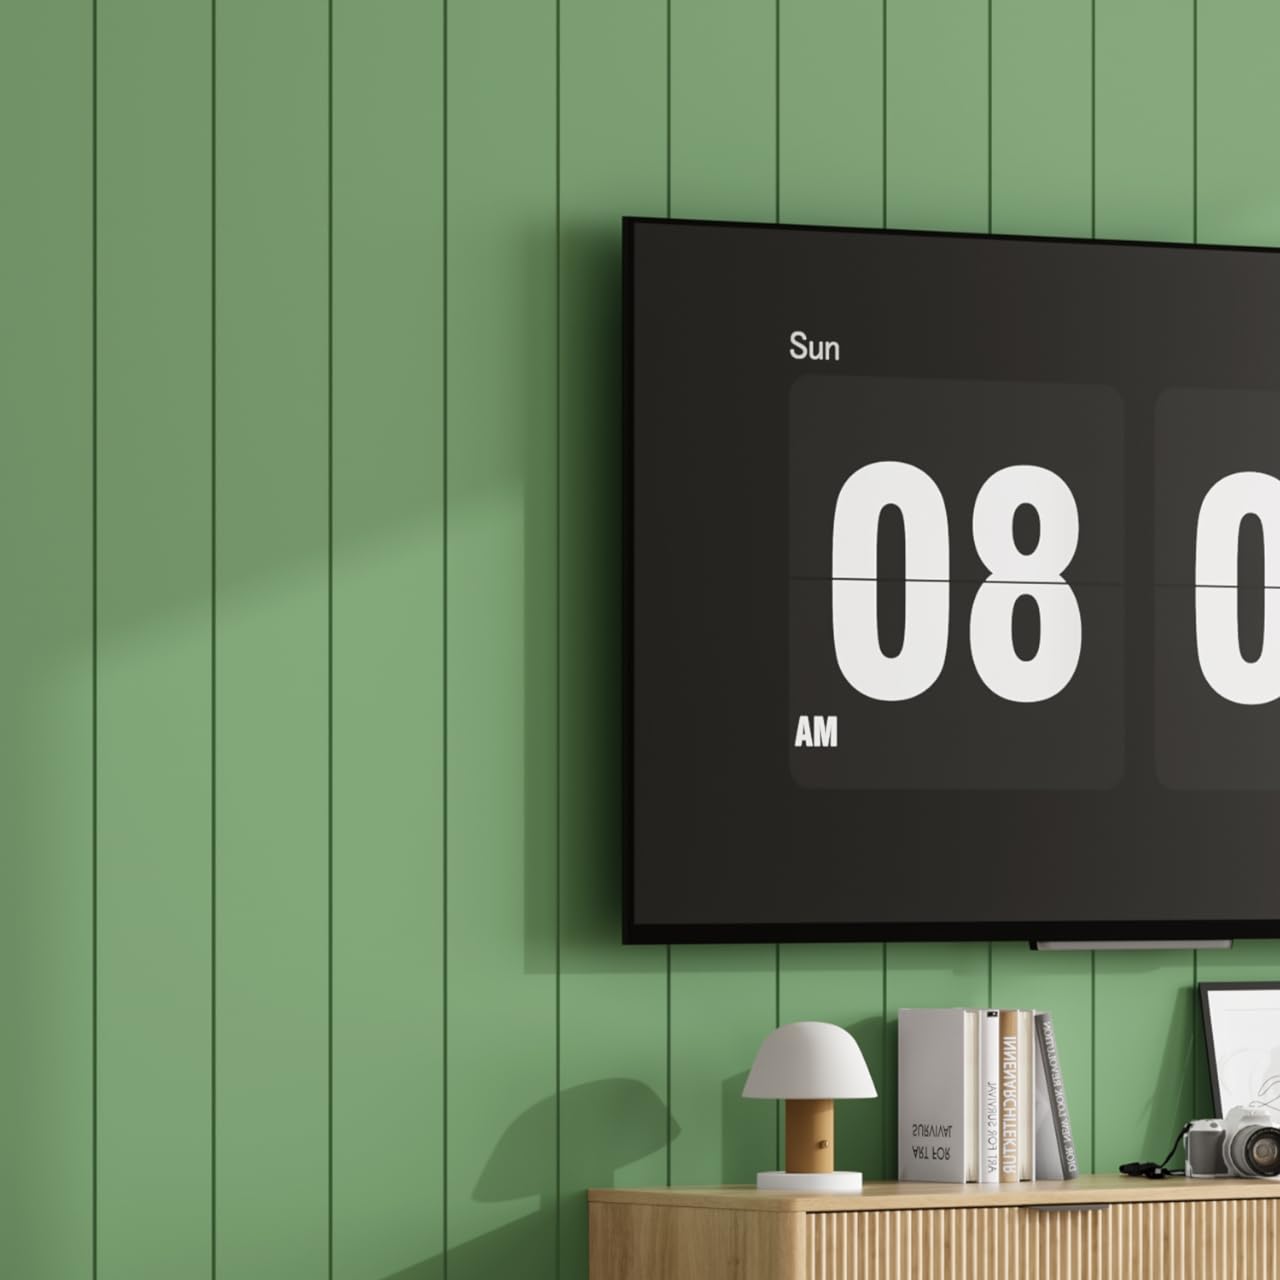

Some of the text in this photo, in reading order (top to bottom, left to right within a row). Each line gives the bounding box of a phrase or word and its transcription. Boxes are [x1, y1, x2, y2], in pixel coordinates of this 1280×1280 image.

[789, 330, 840, 361] Sun
[832, 461, 1083, 703] 08
[794, 715, 838, 747] AM
